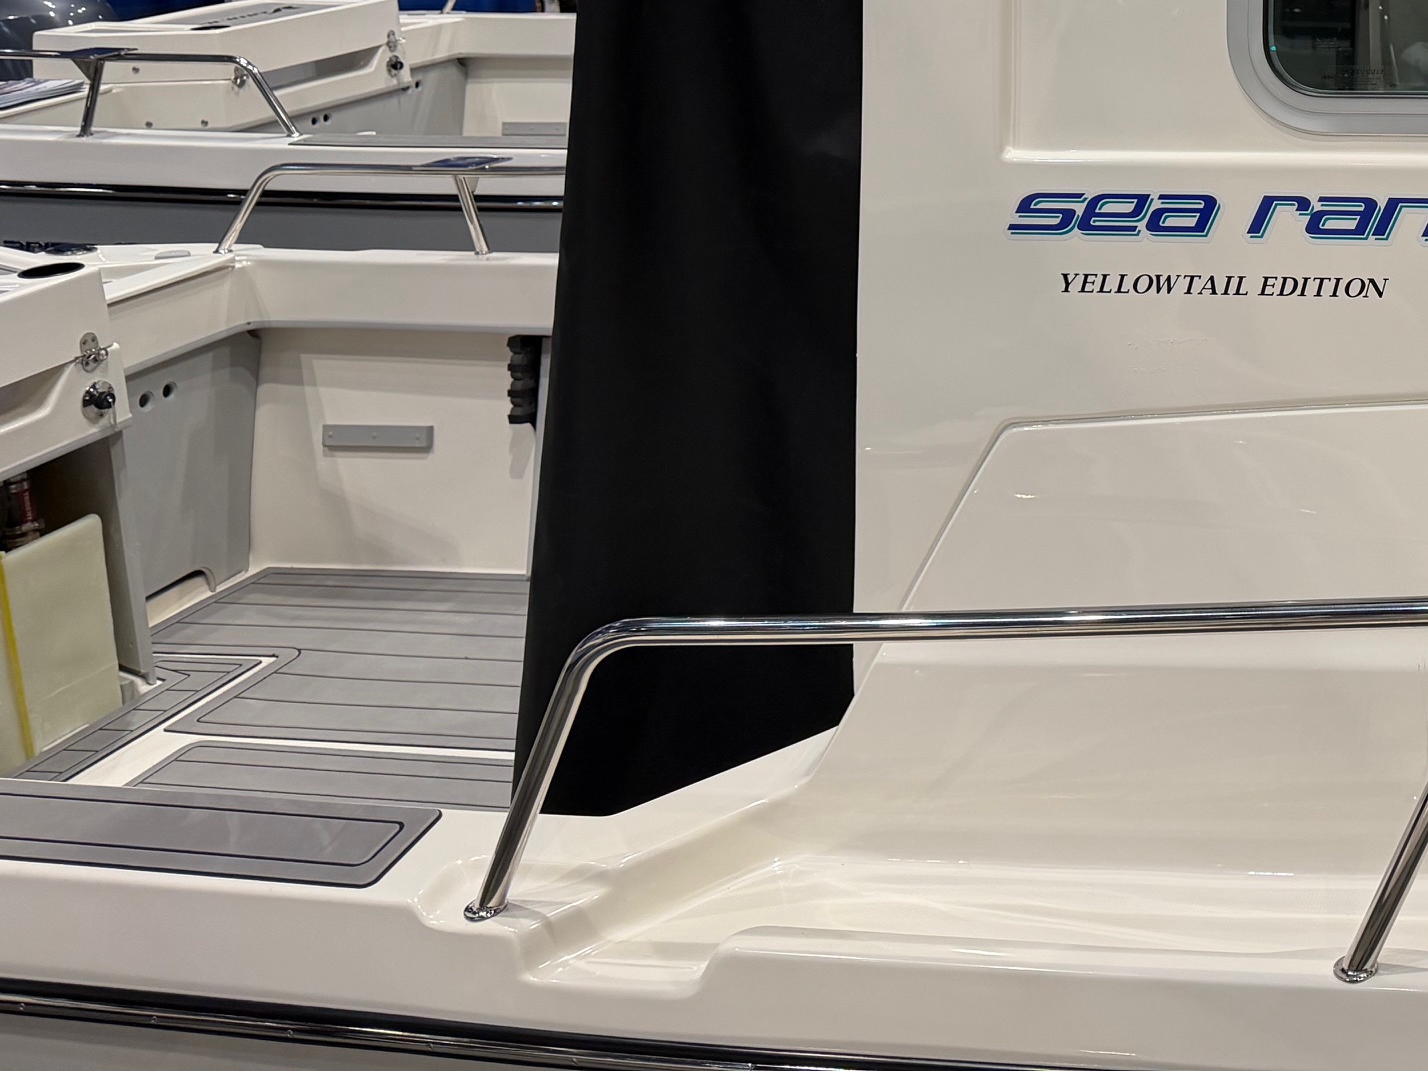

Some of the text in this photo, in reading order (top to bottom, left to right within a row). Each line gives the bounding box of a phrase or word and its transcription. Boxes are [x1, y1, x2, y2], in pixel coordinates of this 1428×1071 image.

[1006, 192, 1221, 238] sea
[1060, 273, 1389, 299] YELLOWTAIL EDITION
